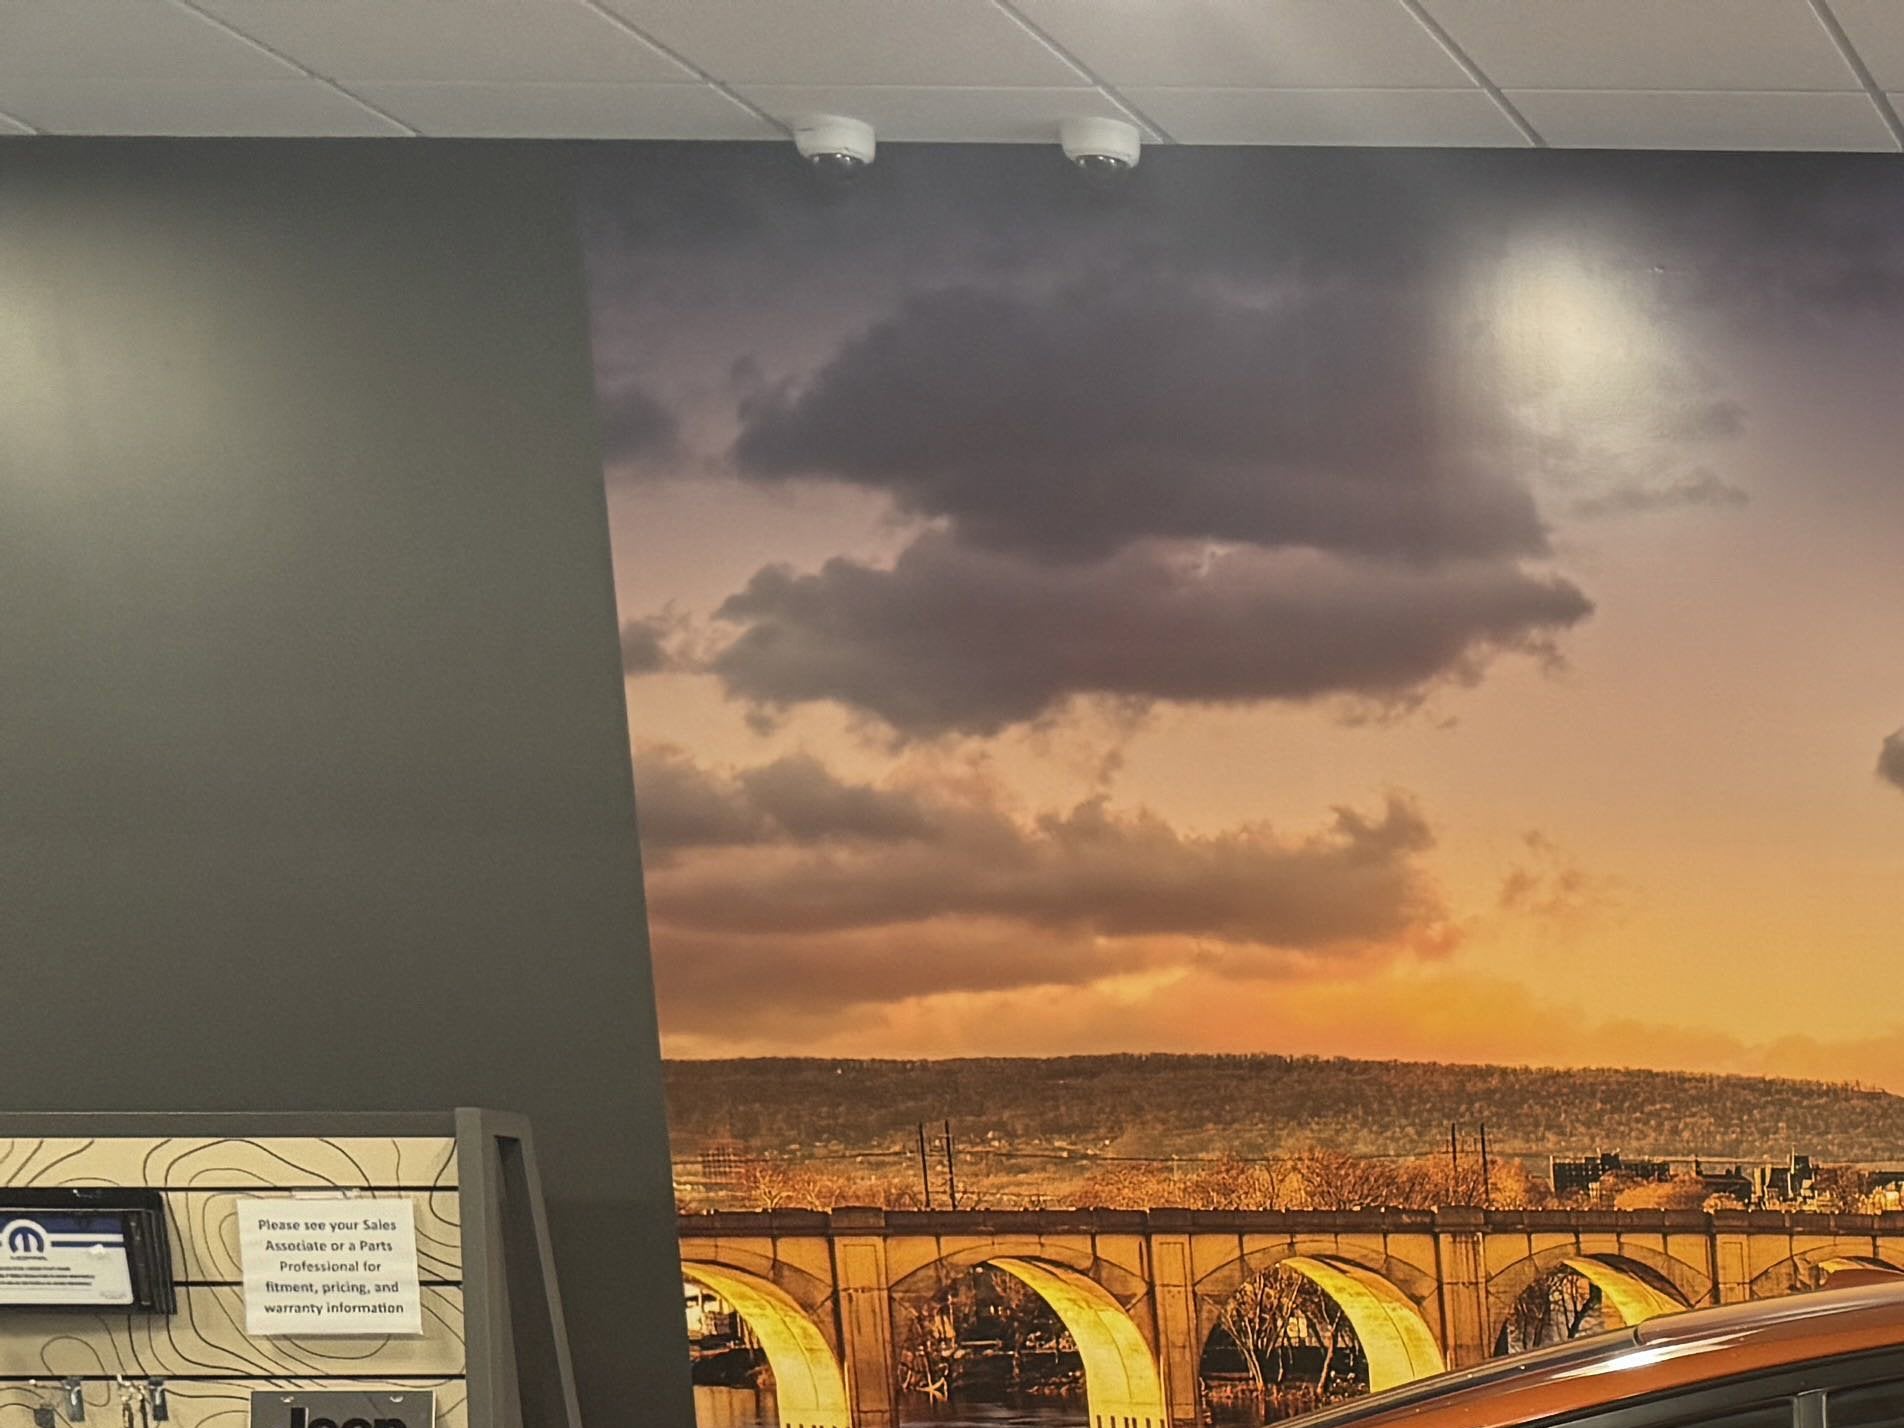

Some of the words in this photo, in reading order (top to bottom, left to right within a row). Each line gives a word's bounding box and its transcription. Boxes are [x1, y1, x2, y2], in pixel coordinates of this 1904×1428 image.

[258, 1219, 300, 1231] Please
[304, 1221, 325, 1231] see
[329, 1221, 359, 1233] your
[363, 1219, 396, 1231] Sales
[265, 1240, 327, 1251] Associate
[330, 1242, 344, 1251] or
[348, 1242, 356, 1251] a
[360, 1240, 393, 1251] Parts
[279, 1260, 359, 1272] Professional
[363, 1260, 381, 1272] for
[265, 1281, 319, 1294] fitment,
[322, 1281, 371, 1295] pricing,
[374, 1281, 399, 1293] and
[264, 1303, 323, 1315] warranty
[326, 1302, 404, 1314] information
